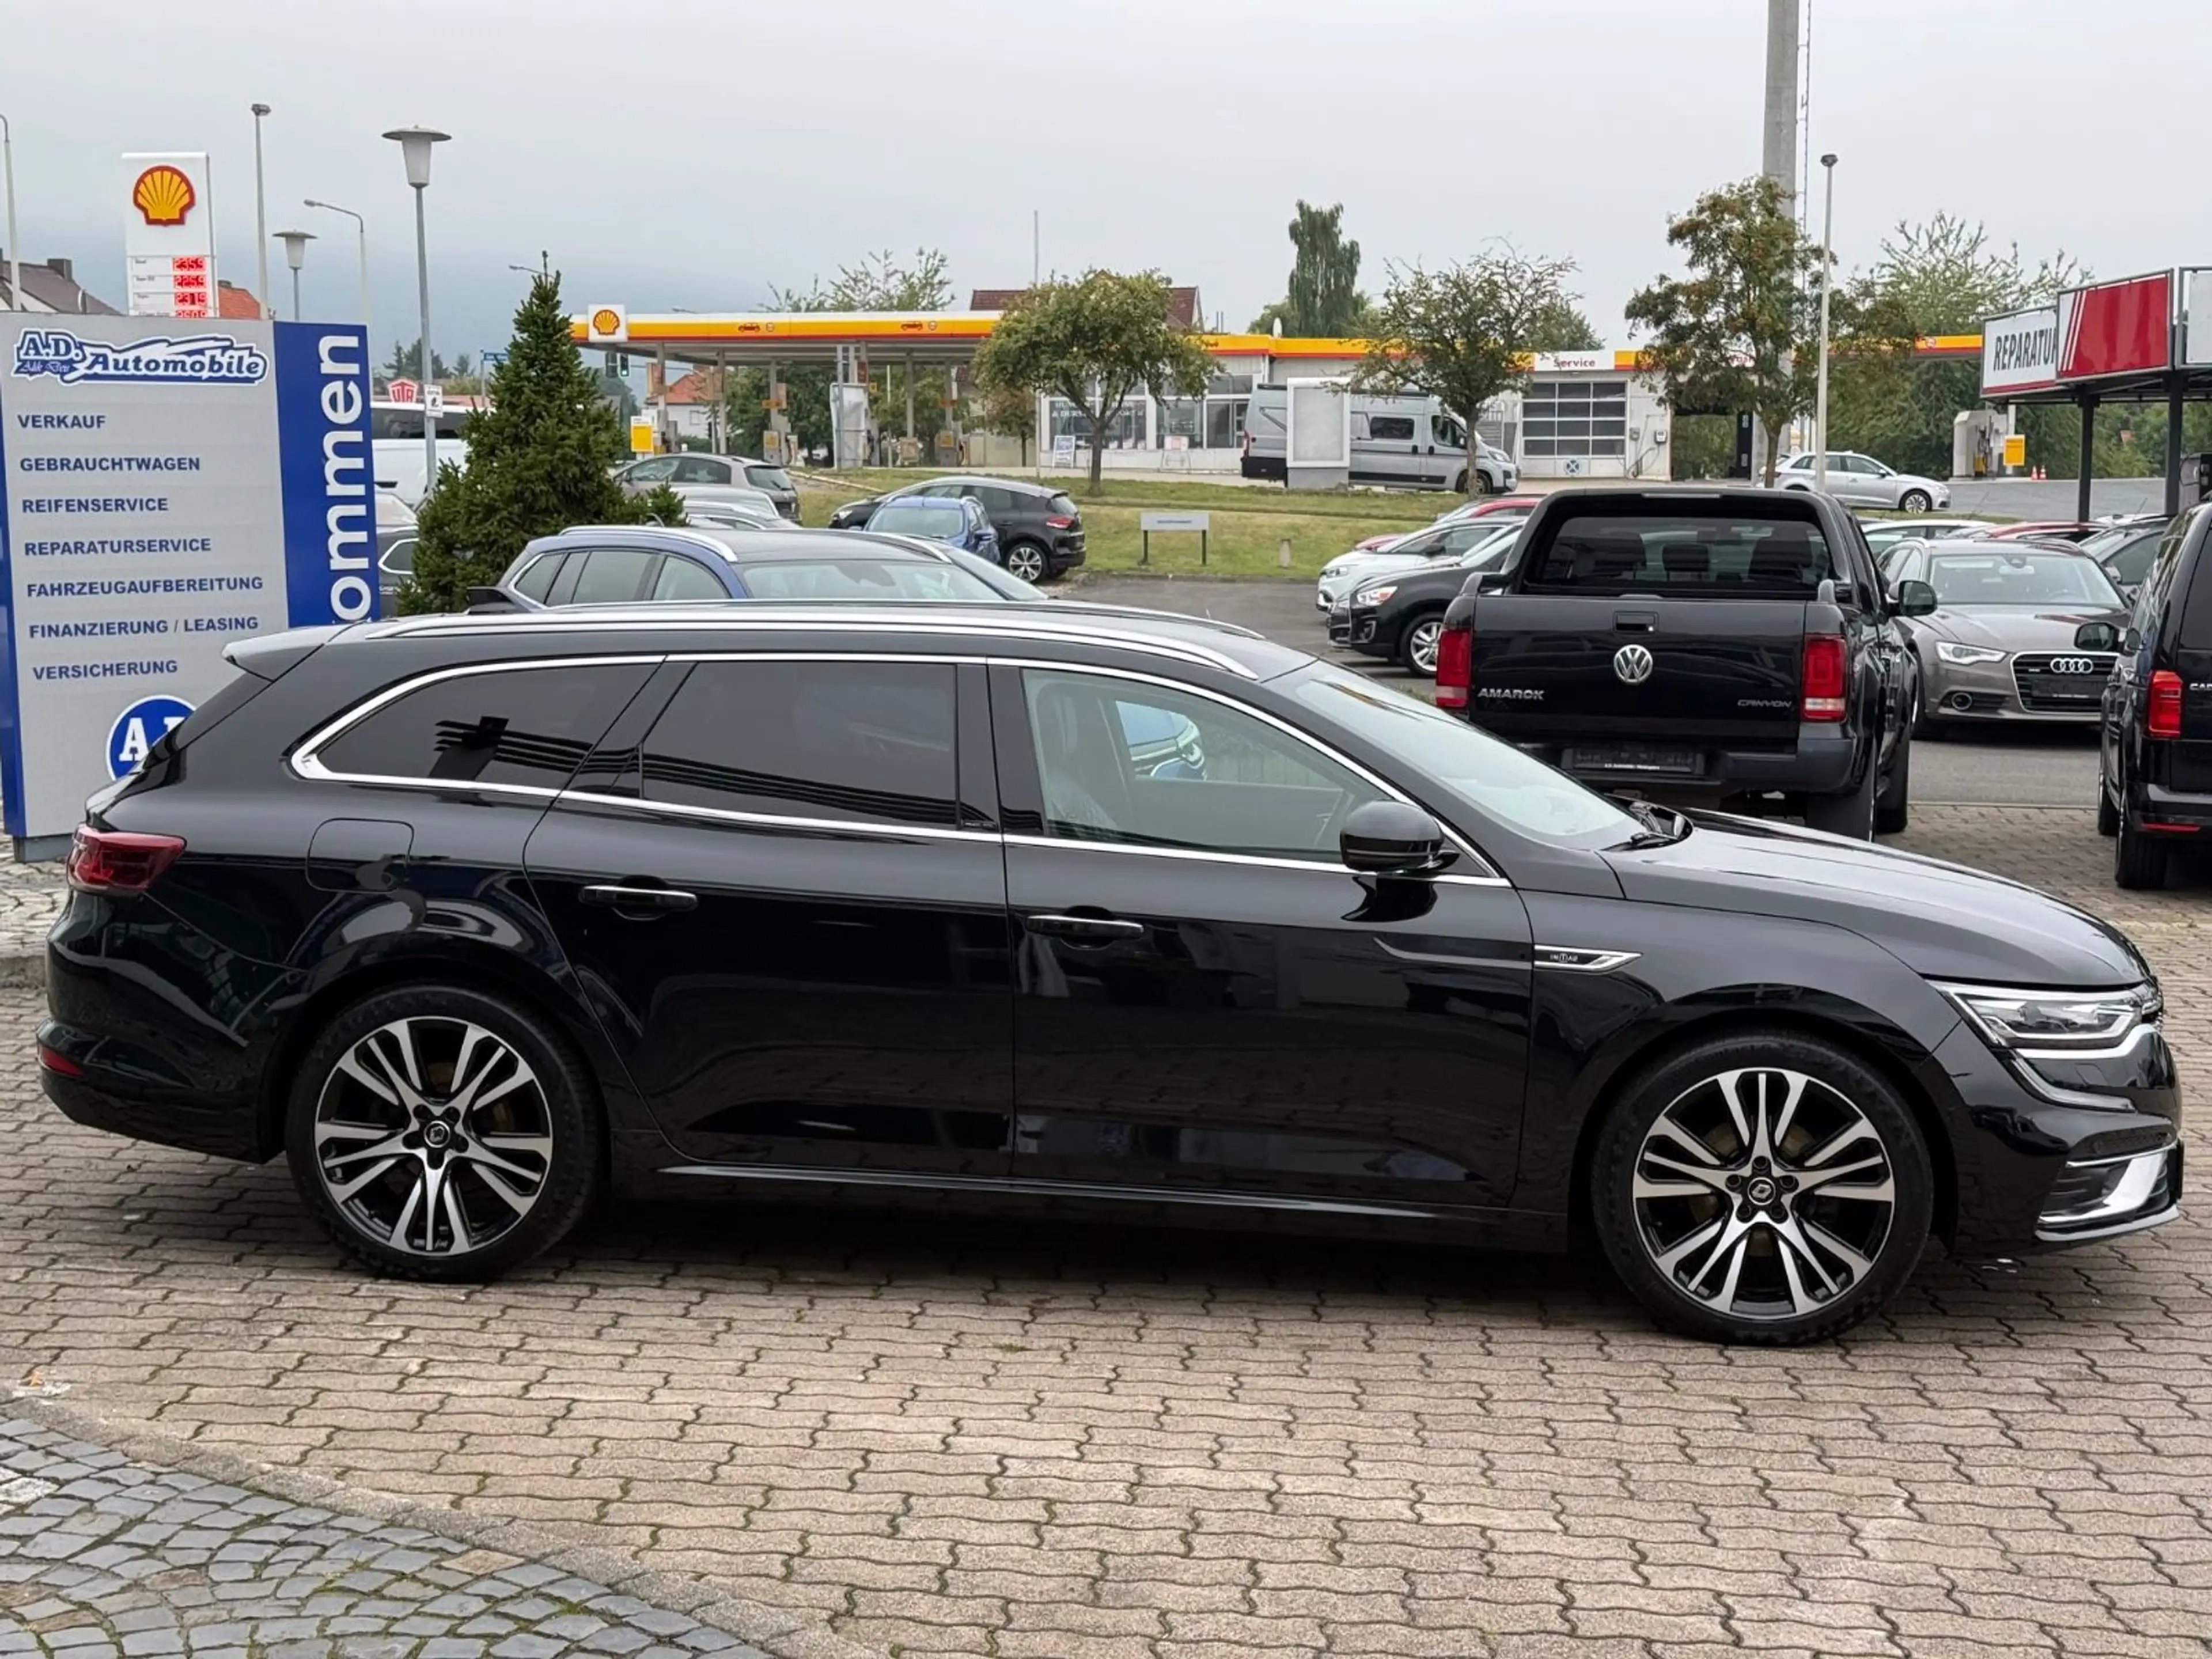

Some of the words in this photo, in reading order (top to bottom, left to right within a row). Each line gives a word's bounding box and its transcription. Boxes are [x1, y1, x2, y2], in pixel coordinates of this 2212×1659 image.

[86, 350, 262, 376] Automobile
[1553, 357, 1596, 369] Service
[18, 415, 105, 428] VERKAUF
[20, 457, 200, 471] GEBRAUCHTWAGEN
[318, 336, 372, 622] ommen
[22, 498, 168, 513] REIFENSERVICE
[25, 539, 210, 556] REPARATURSERVICE
[27, 577, 263, 597] FAHRZEUGAUFBEREITUNG
[29, 620, 168, 638] FINANZIERUNG
[184, 616, 258, 632] LEASING
[33, 660, 177, 680] VERSICHERUNG
[1477, 687, 1545, 701] AMAROK
